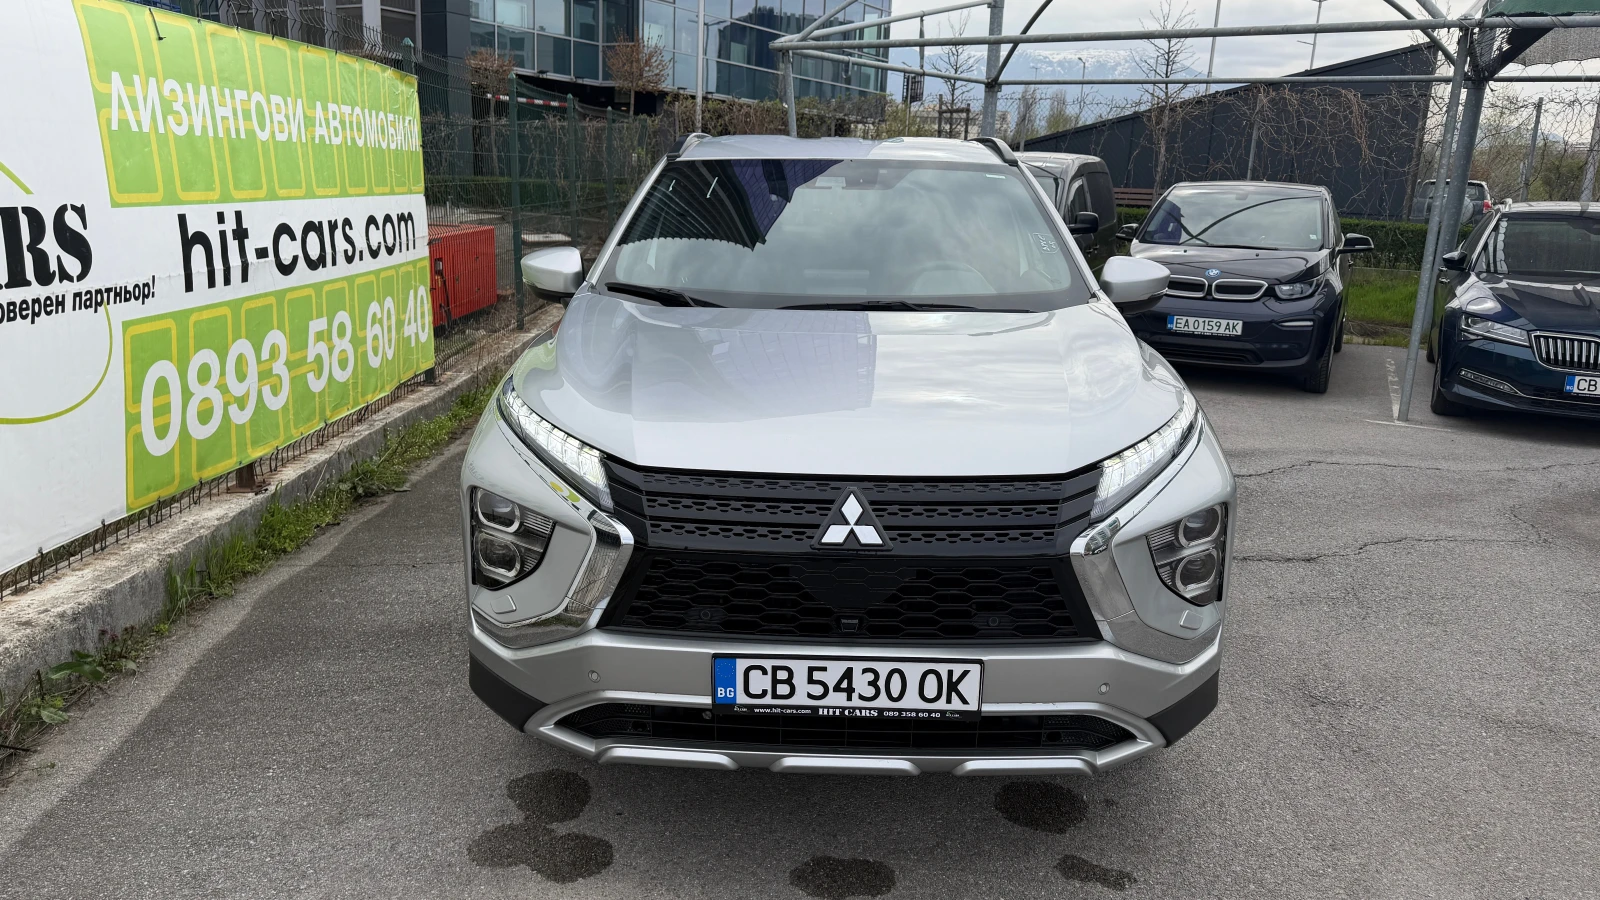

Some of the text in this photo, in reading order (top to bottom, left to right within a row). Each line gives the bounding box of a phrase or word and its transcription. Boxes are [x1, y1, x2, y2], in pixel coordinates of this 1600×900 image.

[111, 71, 419, 151] ЛИЗИНГОВИ АВТОМОБИЛИ
[0, 204, 93, 290] RS
[177, 210, 416, 293] hit-cars.com
[72, 275, 156, 314] партньор!
[1174, 318, 1190, 330] EA
[1193, 319, 1222, 332] 0159
[1223, 321, 1240, 334] AK
[141, 285, 429, 457] 0893 58 60 40
[1576, 378, 1598, 392] CB
[717, 687, 735, 698] BG
[743, 664, 971, 705] CB 5430 OK
[753, 707, 812, 715] www.hit-cars.com
[818, 707, 842, 716] HIT
[844, 708, 879, 717] CARS
